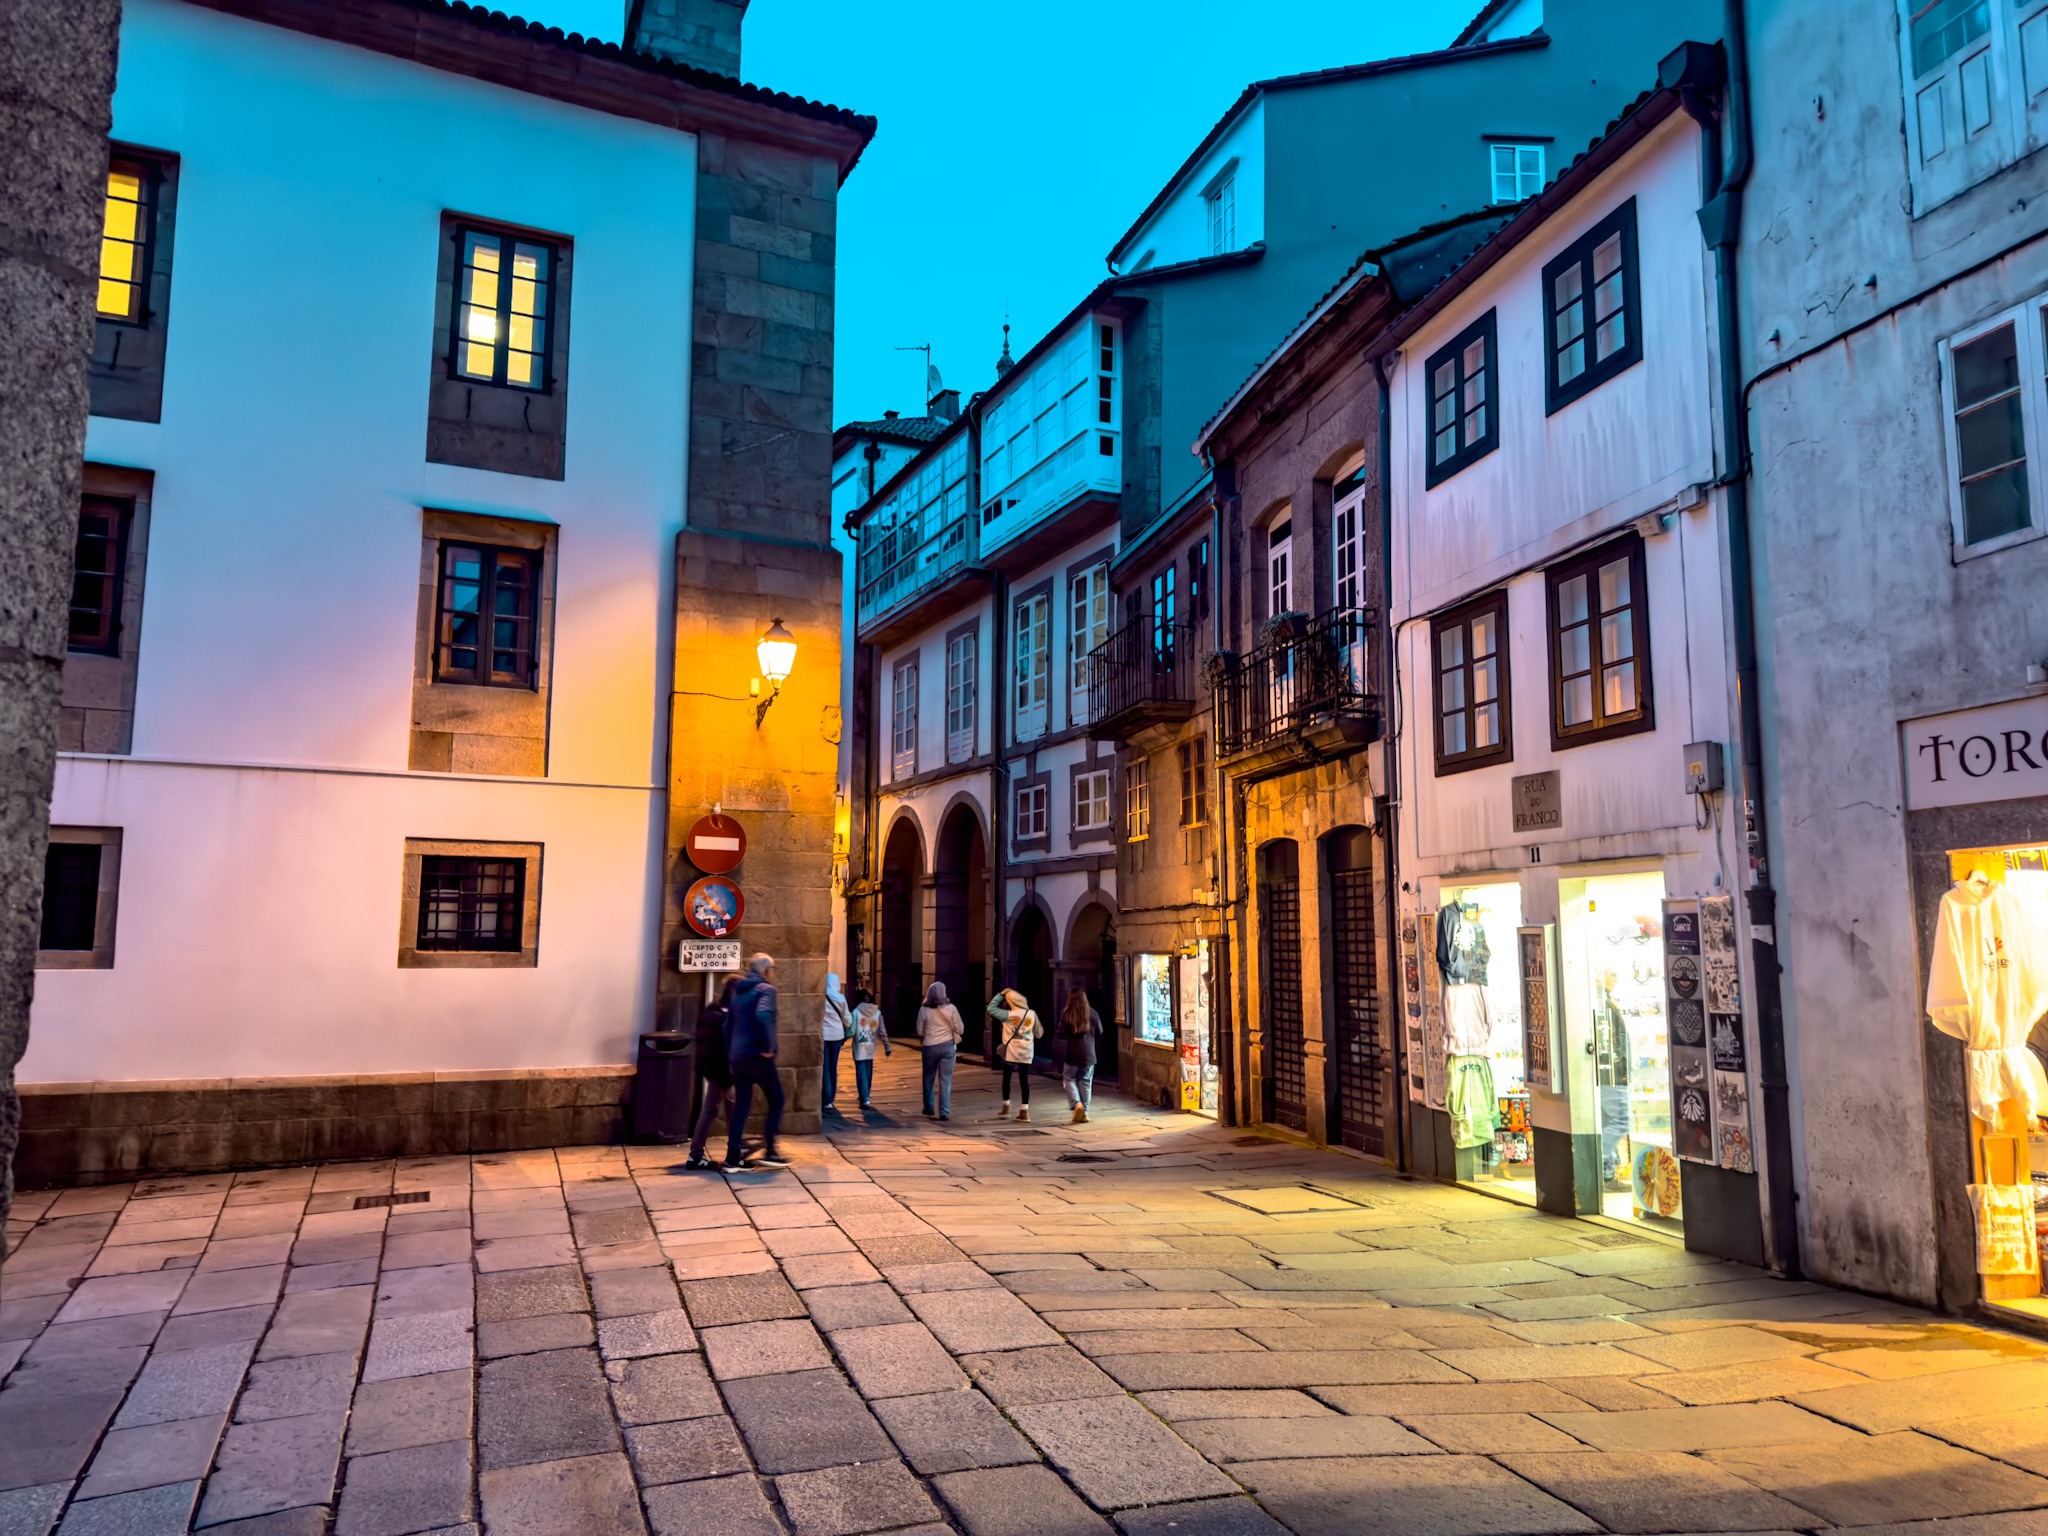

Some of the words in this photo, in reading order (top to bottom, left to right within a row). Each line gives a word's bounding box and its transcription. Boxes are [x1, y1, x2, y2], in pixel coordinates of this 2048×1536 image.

[1919, 729, 2048, 782] TOR
[1516, 809, 1559, 828] FRANCO
[1530, 846, 1541, 863] 11
